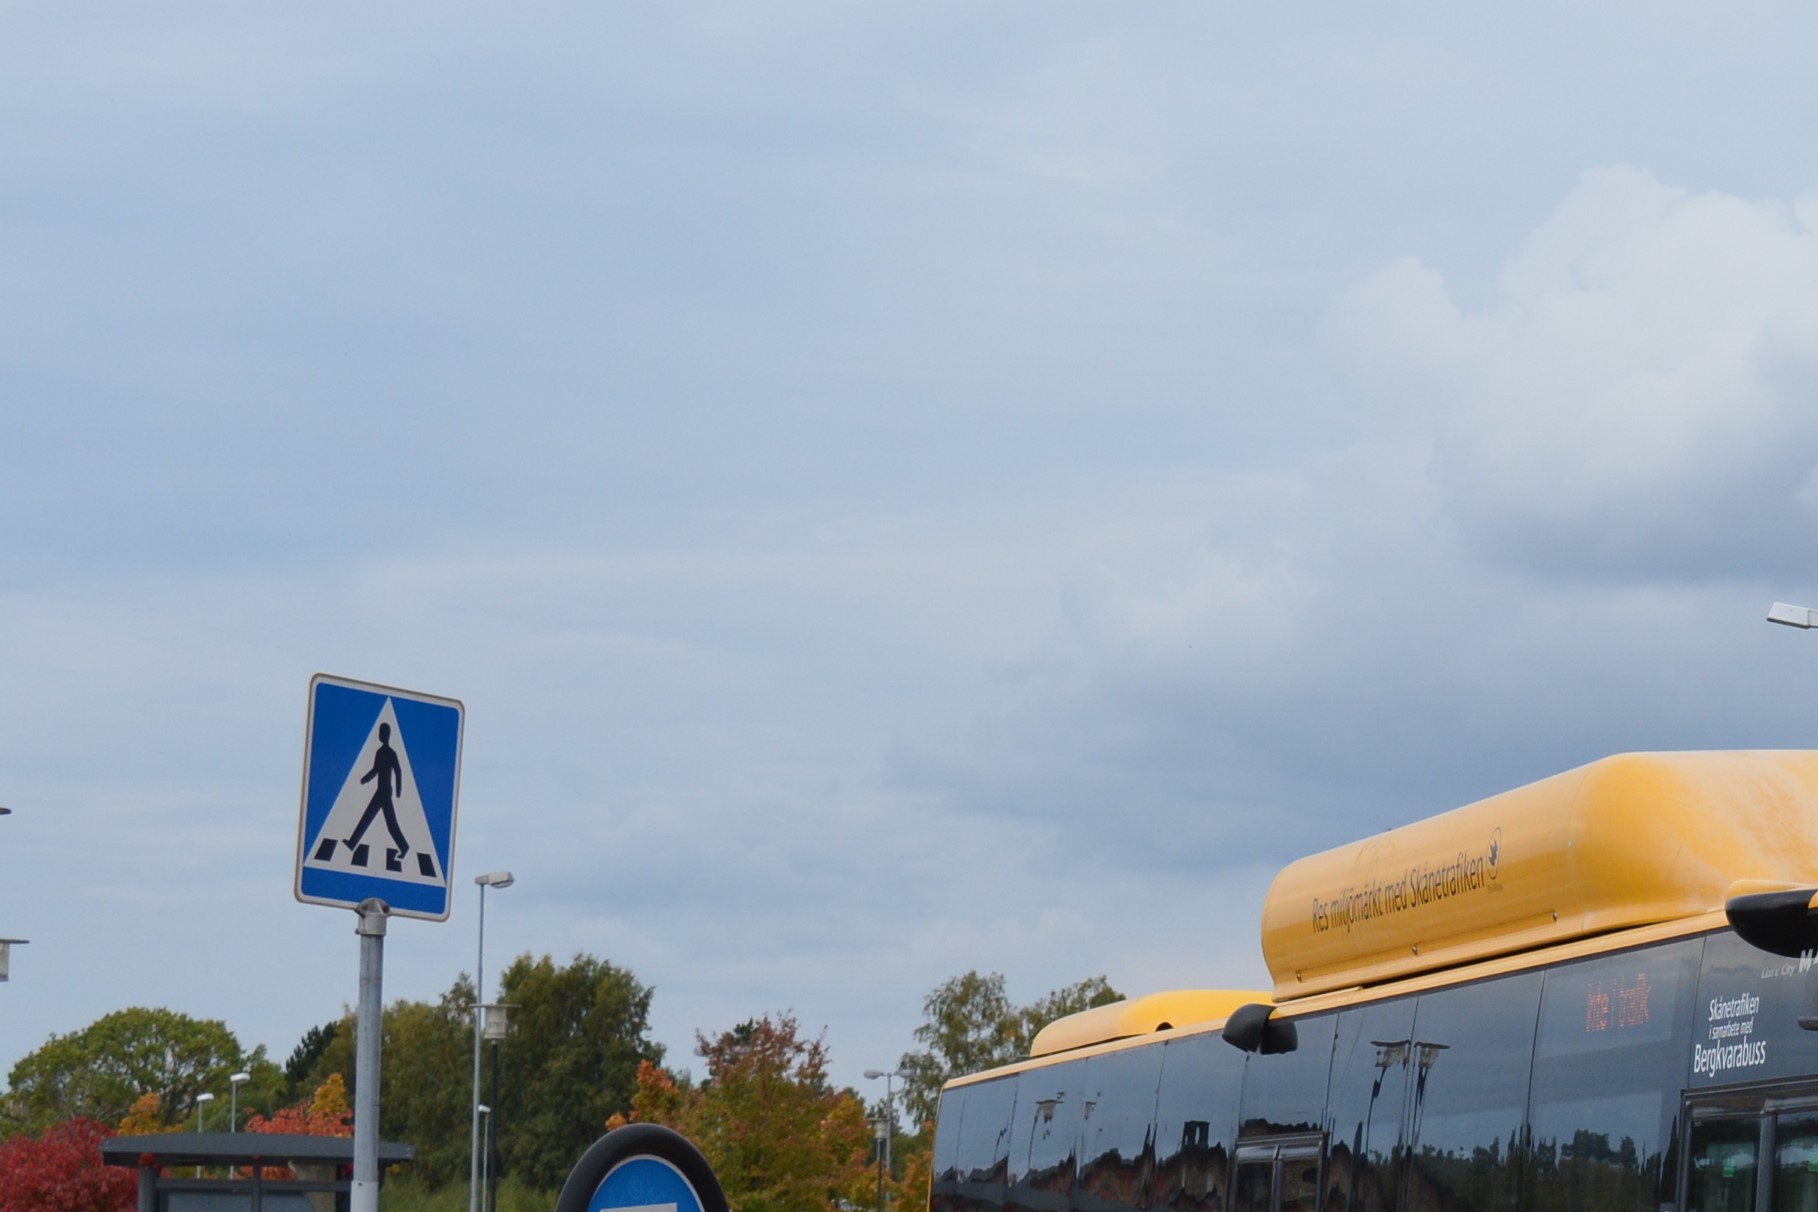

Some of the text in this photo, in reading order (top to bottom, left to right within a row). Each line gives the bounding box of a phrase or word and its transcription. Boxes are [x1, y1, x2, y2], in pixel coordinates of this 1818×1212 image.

[1312, 850, 1486, 933] Res miljömärkt med Skånetrafiken
[1708, 992, 1760, 1022] Skånetrafiken
[1711, 1020, 1740, 1040] samarbete
[1740, 1017, 1754, 1035] med
[1693, 1035, 1767, 1079] Bergkvarabuss
